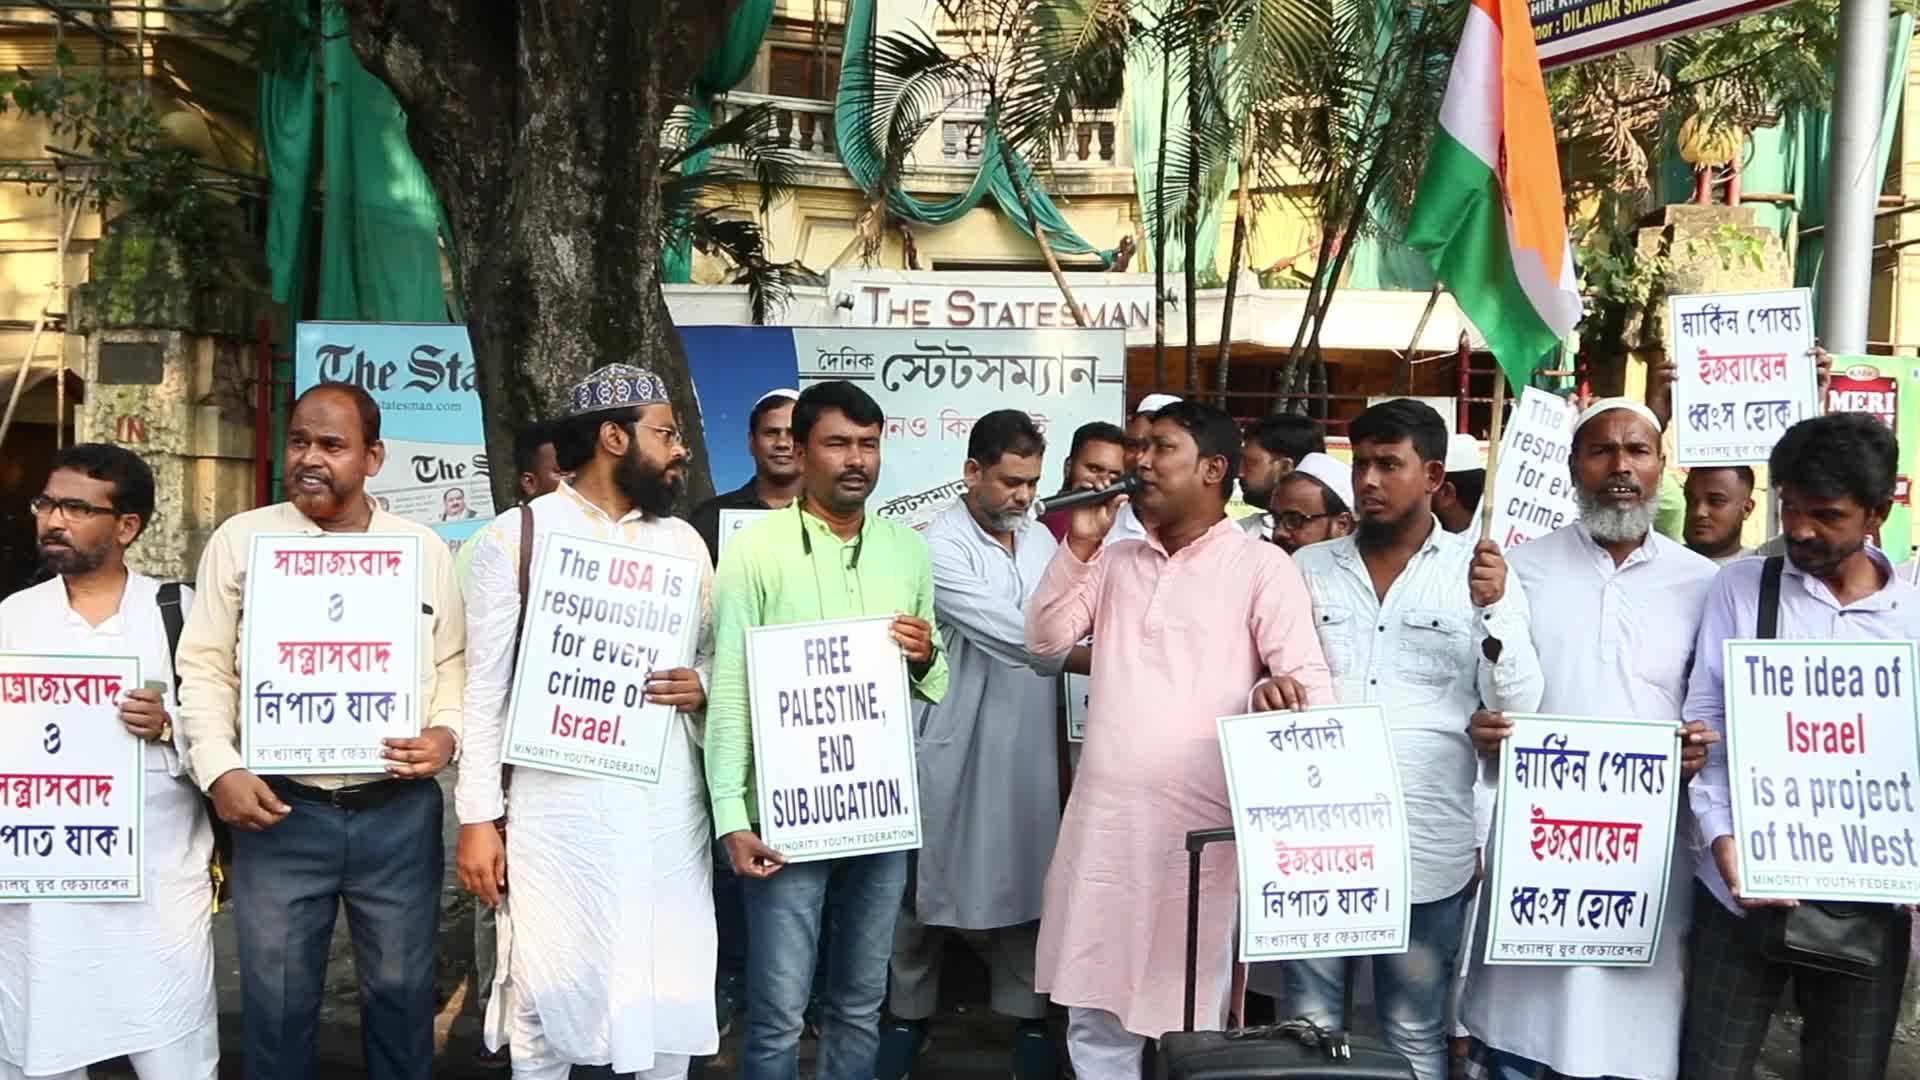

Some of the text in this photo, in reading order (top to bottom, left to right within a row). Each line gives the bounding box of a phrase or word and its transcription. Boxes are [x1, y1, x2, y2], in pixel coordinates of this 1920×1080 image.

[1563, 3, 1621, 32] DILAWAR
[863, 286, 1150, 328] THE STATESMAN
[1681, 303, 1801, 336] মার্কিন পোষ্য
[316, 344, 397, 391] The
[816, 339, 1102, 395] দৈনিক স্টেটসম্যান
[1697, 349, 1787, 384] ইজরায়েল
[1529, 400, 1563, 428] The
[1688, 402, 1735, 432] ধ্বংস
[1828, 390, 1895, 413] MERI
[116, 415, 145, 443] IN
[1512, 430, 1568, 465] respo
[411, 455, 466, 483] The
[1516, 461, 1546, 490] for
[1507, 497, 1565, 530] crime
[274, 551, 403, 576] সাম্রাজ্যবাদ
[560, 548, 683, 598] The USA is
[328, 593, 344, 622] ও
[541, 589, 682, 636] responsible
[277, 641, 392, 676] সন্ত্রাসবাদ
[552, 624, 660, 674] for every
[804, 635, 852, 677] FREE
[0, 673, 122, 706] াম্রাজ্যবাদ
[548, 668, 616, 705] crime
[1745, 656, 1901, 697] The idea of
[254, 681, 338, 724] নিপাত
[779, 682, 887, 728] PALESTINE,
[44, 723, 61, 754] ও
[552, 704, 626, 747] Israel.
[1267, 718, 1345, 751] বর্ণবাদী
[1787, 712, 1865, 754] Israel
[513, 743, 657, 777] MINORITY YOUTH FEDERATION
[818, 734, 855, 774] END
[1515, 733, 1668, 795] মার্কিন পোষ্য
[1307, 765, 1322, 788] ও
[1751, 766, 1914, 819] is a project
[772, 778, 909, 828] SUBJUGATION.
[1246, 793, 1392, 832] সম্প্রসারণবাদী
[0, 825, 55, 857] পাত
[774, 829, 915, 851] MINORITY YOUTH FEDERATION
[1530, 803, 1642, 865] ইজরায়েল
[1751, 821, 1776, 862] of
[1787, 823, 1834, 863] the
[1273, 838, 1374, 876] ইজরায়েল
[1262, 881, 1330, 918] নিপাত
[1753, 874, 1920, 890] MINORITY YOUTH FEDERATI
[1510, 886, 1570, 927] ধ্বংস
